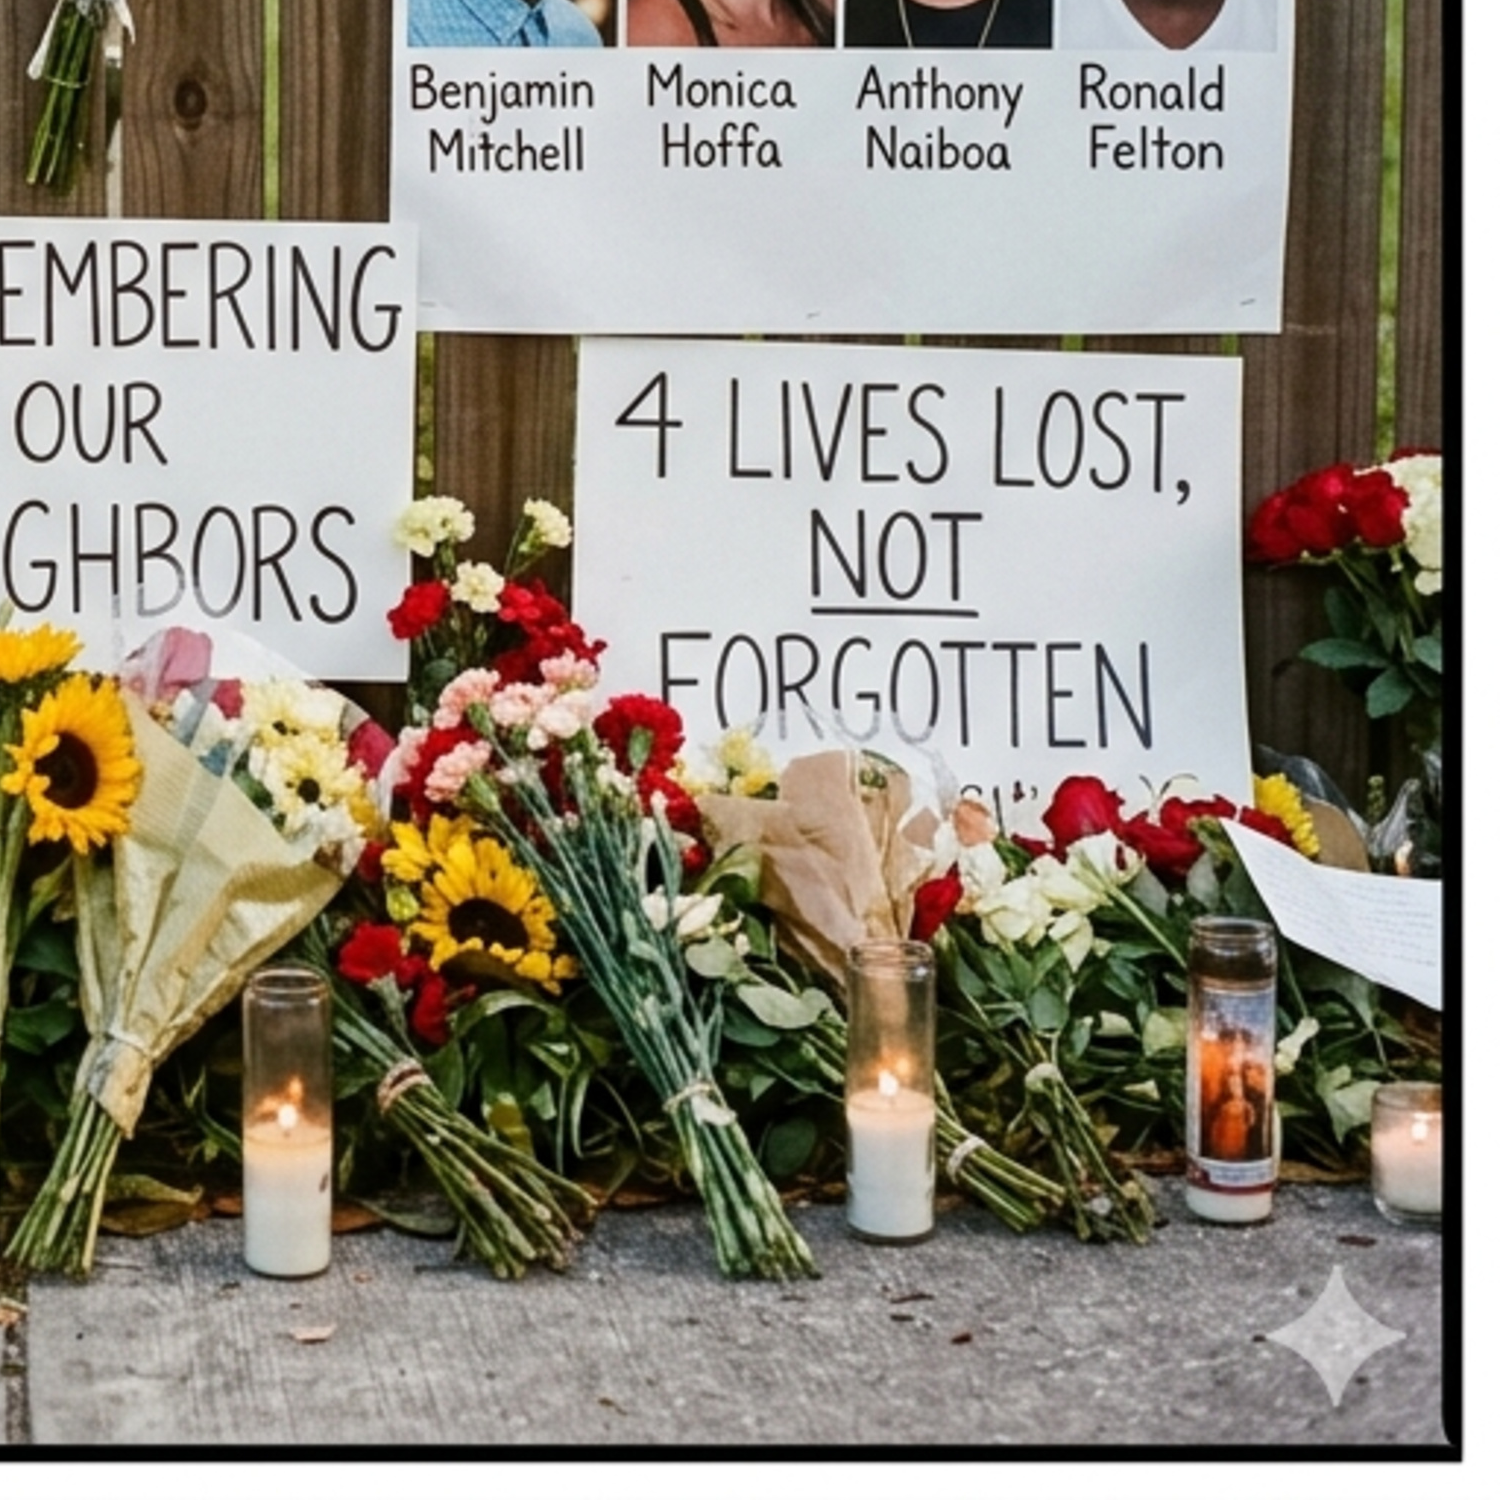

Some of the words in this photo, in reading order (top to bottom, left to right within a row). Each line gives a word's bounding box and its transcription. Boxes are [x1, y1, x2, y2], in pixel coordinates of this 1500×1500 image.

[409, 63, 594, 124] Benjamin
[647, 63, 797, 109] Monica
[856, 64, 1025, 128] Anthony
[1079, 62, 1225, 112] Ronald
[428, 128, 585, 173] Mitchell
[661, 121, 782, 169] Hoffa
[866, 124, 1011, 171] Naiboa
[1089, 124, 1225, 170] Felton
[14, 380, 168, 466] OUR
[614, 371, 683, 479] 4
[730, 377, 948, 485] LIVES
[994, 386, 1190, 505] LOST,
[810, 508, 983, 602] NOT
[661, 632, 1153, 750] FORGOTTEN
